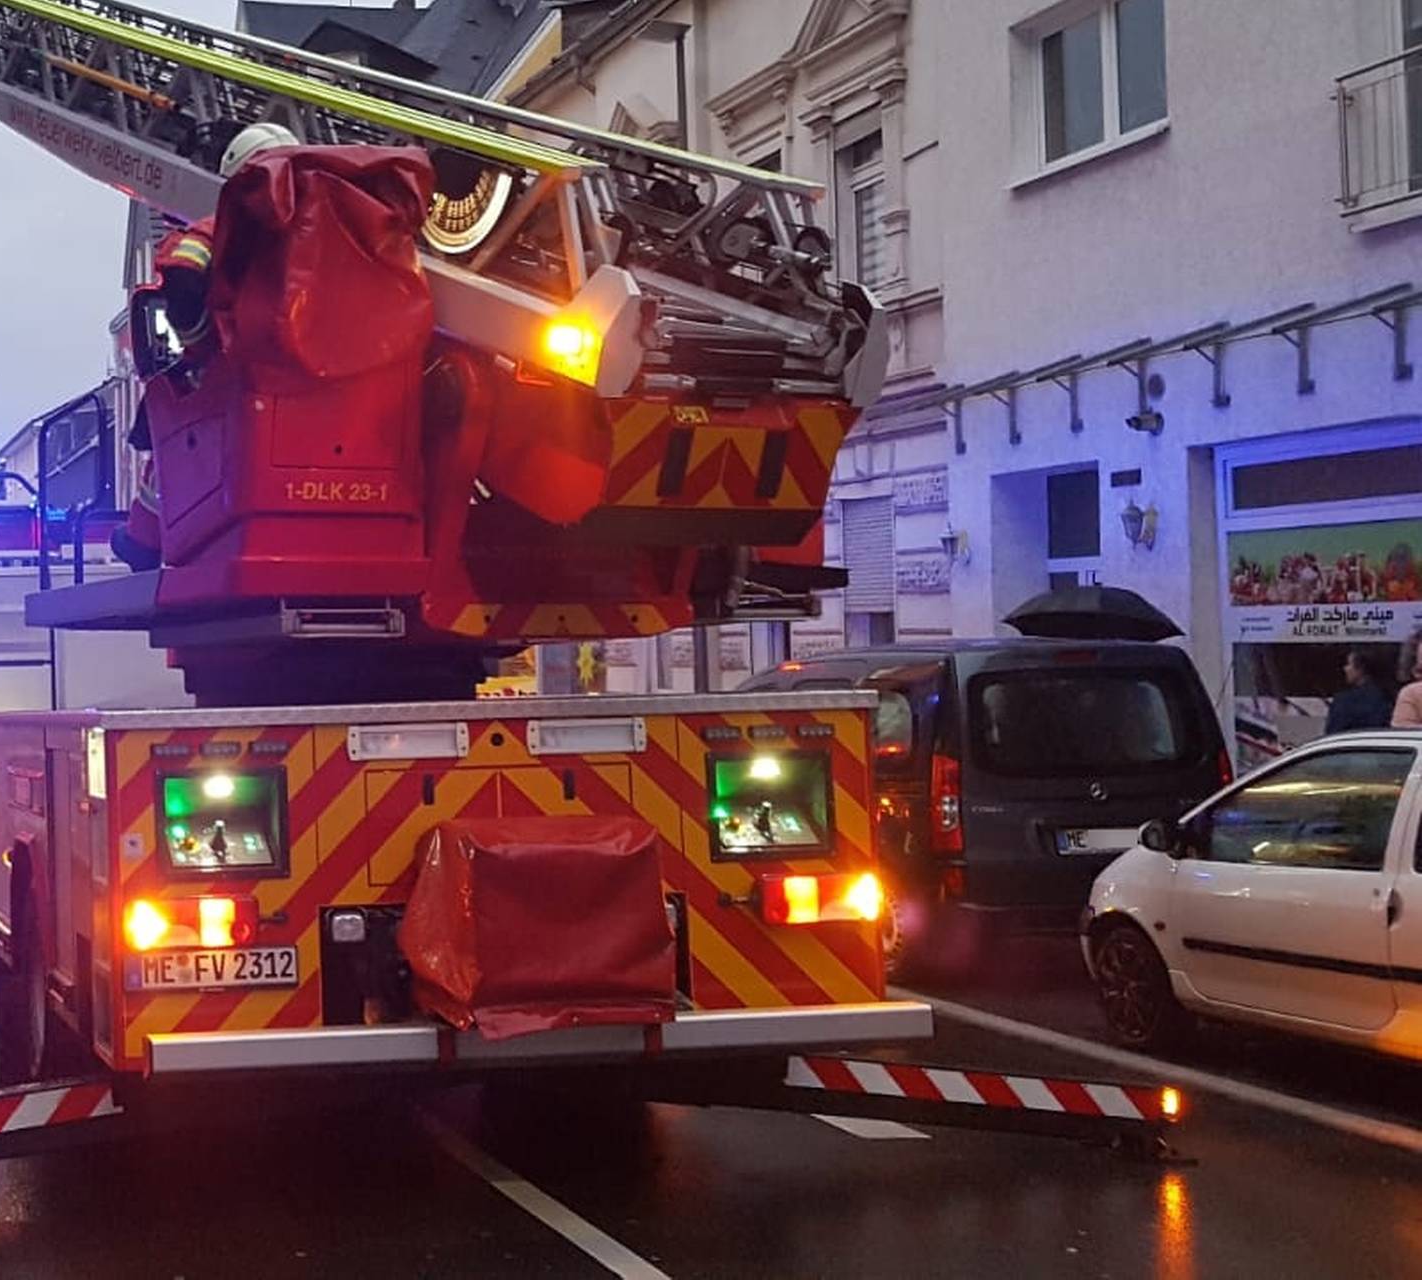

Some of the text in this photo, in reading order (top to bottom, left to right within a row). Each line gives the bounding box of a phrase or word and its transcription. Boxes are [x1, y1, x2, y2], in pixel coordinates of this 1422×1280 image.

[285, 481, 387, 501] 1-DLK 23-1
[1067, 830, 1088, 848] ME
[144, 950, 294, 984] ME FV 2312
